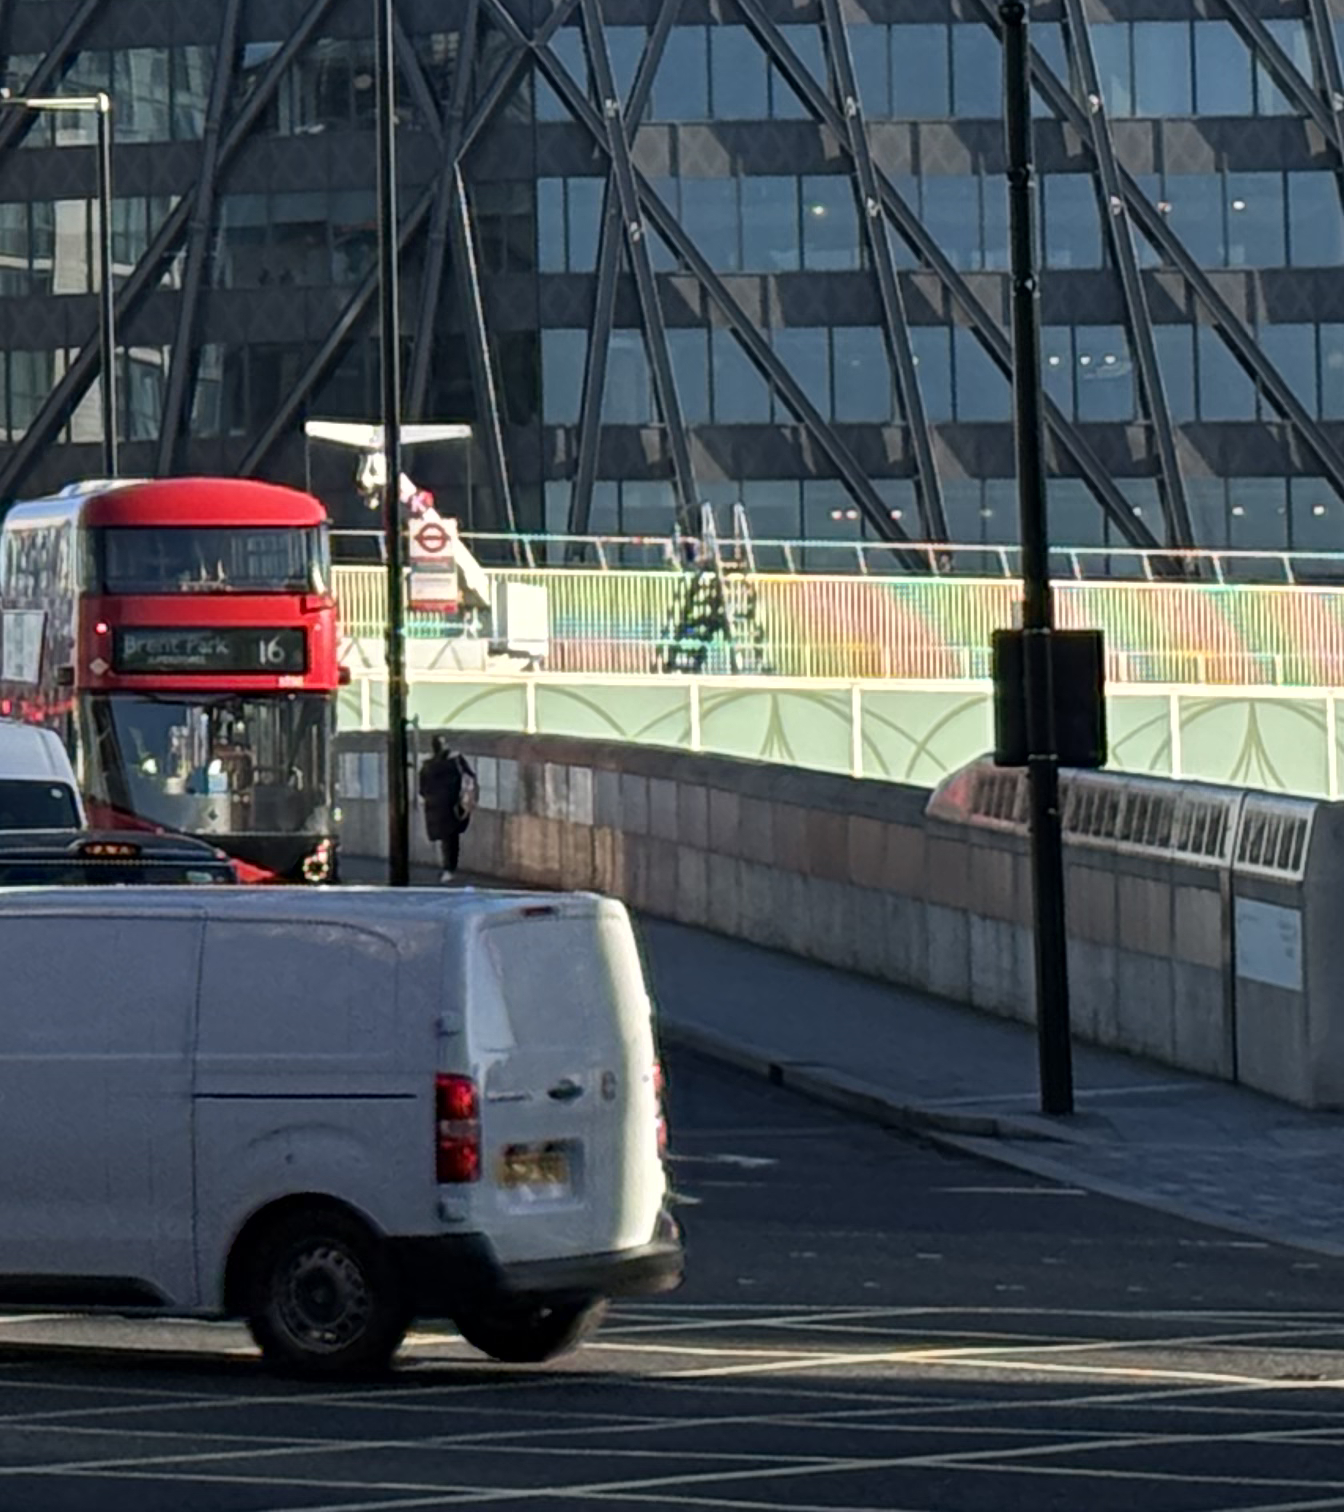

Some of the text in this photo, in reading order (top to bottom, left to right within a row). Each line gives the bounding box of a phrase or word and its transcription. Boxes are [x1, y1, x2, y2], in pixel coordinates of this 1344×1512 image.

[123, 635, 286, 665] Brent Park 16
